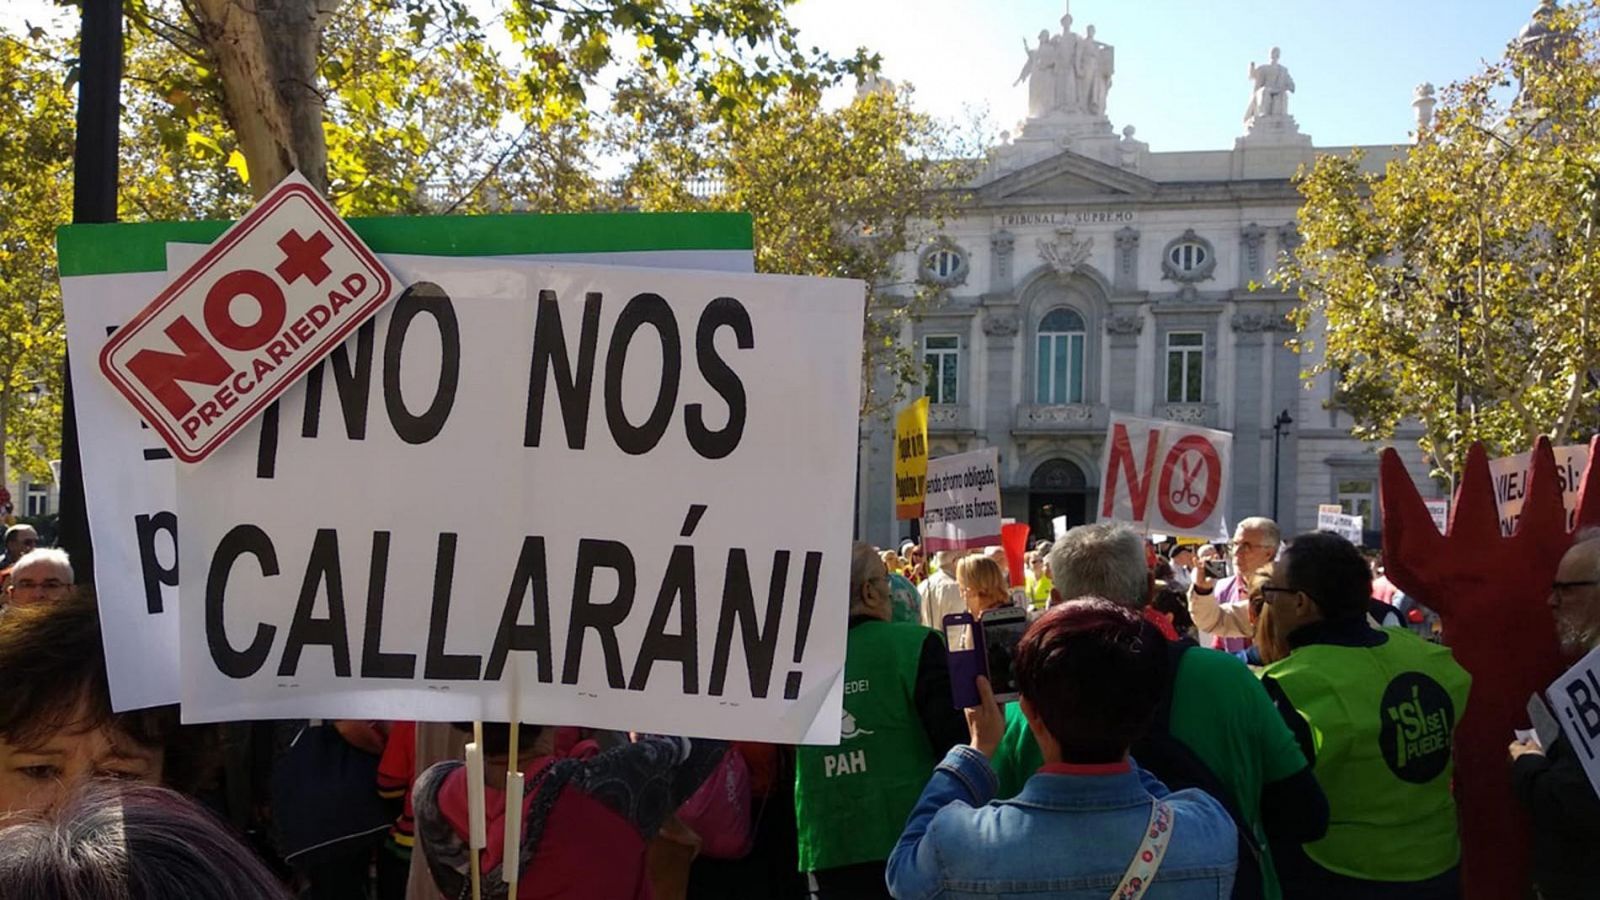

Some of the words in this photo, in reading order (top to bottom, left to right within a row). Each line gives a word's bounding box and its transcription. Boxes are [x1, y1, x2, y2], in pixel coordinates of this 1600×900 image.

[1001, 214, 1056, 225] TRIBUNAL
[1075, 211, 1134, 223] SUPREMO
[180, 272, 368, 441] PRECARIEDAD
[524, 289, 754, 459] NOS
[926, 473, 942, 494] endo
[943, 472, 962, 491] ahorro
[1102, 424, 1222, 529] NO
[1496, 470, 1528, 504] VIEJ
[965, 503, 974, 519] es
[205, 504, 823, 700] CALLARÁN!
[845, 680, 869, 694] EDE!
[1427, 712, 1442, 731] SE
[824, 750, 867, 777] PAH
